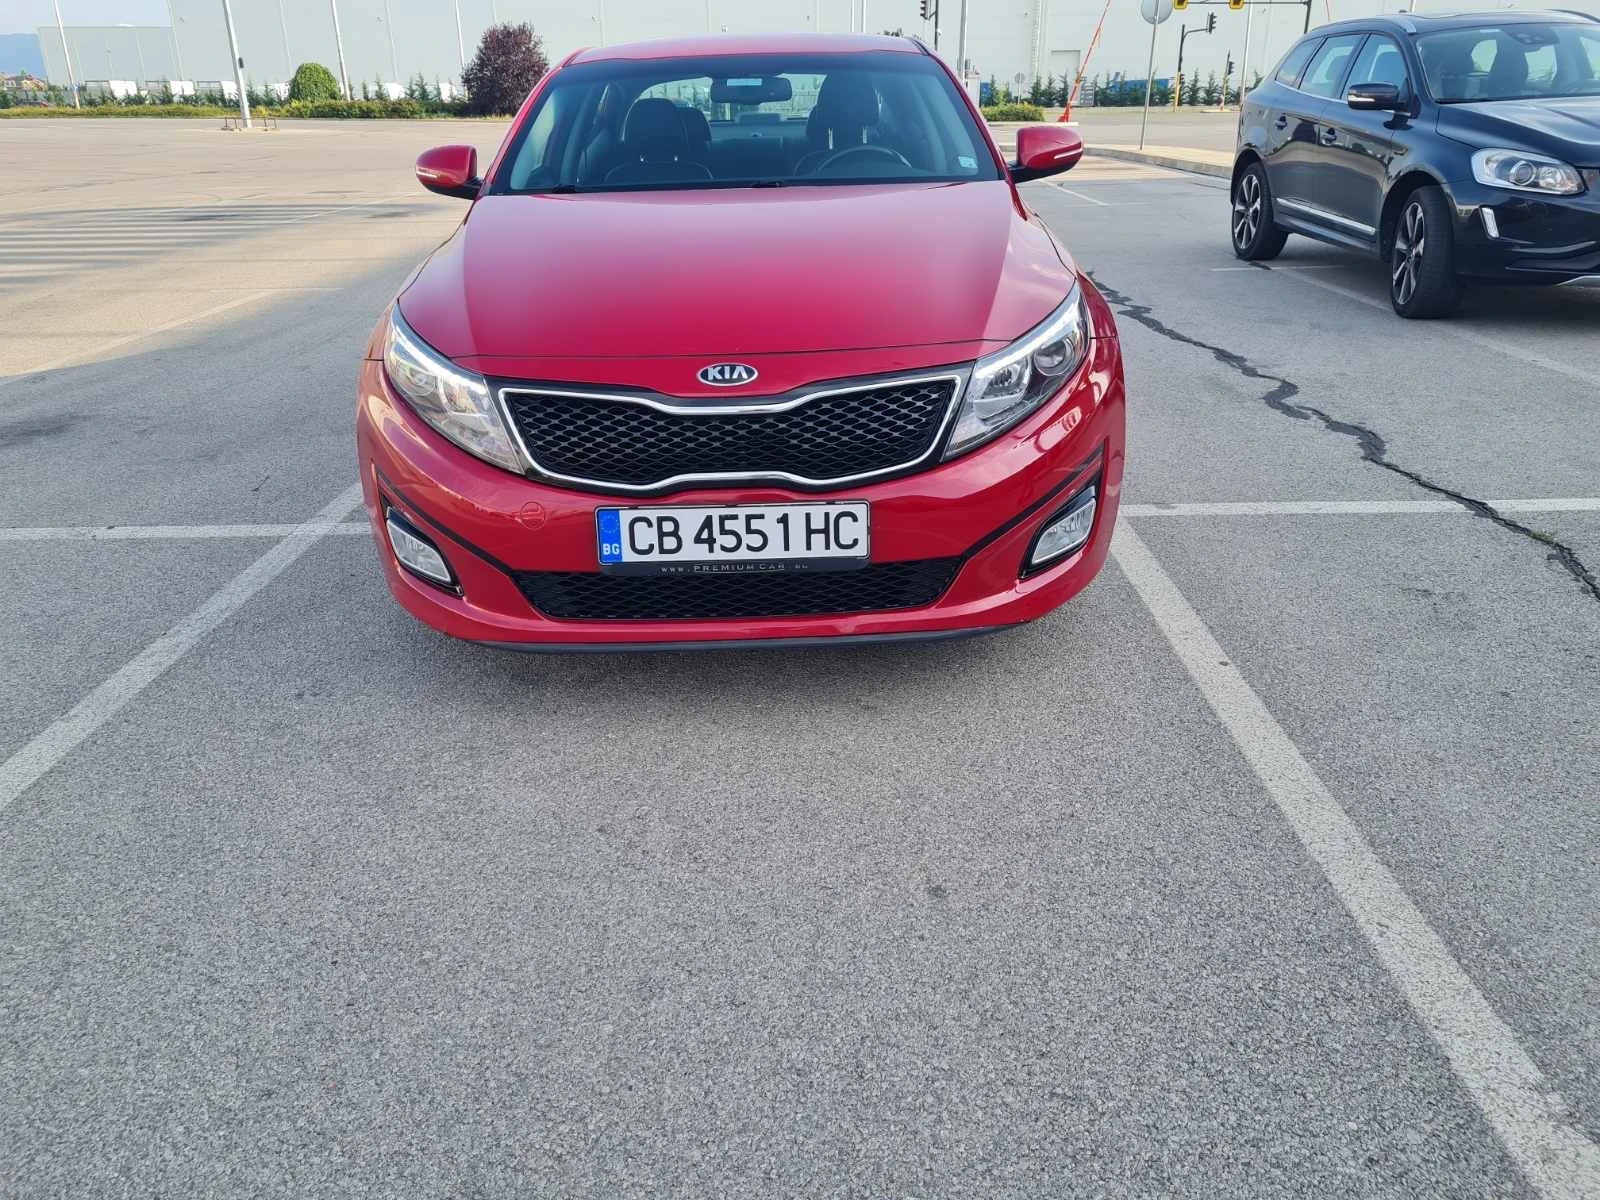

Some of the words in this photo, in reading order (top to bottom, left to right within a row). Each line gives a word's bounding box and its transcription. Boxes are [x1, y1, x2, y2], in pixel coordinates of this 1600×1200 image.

[707, 365, 748, 381] KIA
[628, 515, 683, 556] CB
[693, 513, 791, 554] 4551
[805, 511, 859, 551] HC
[602, 543, 620, 555] BG
